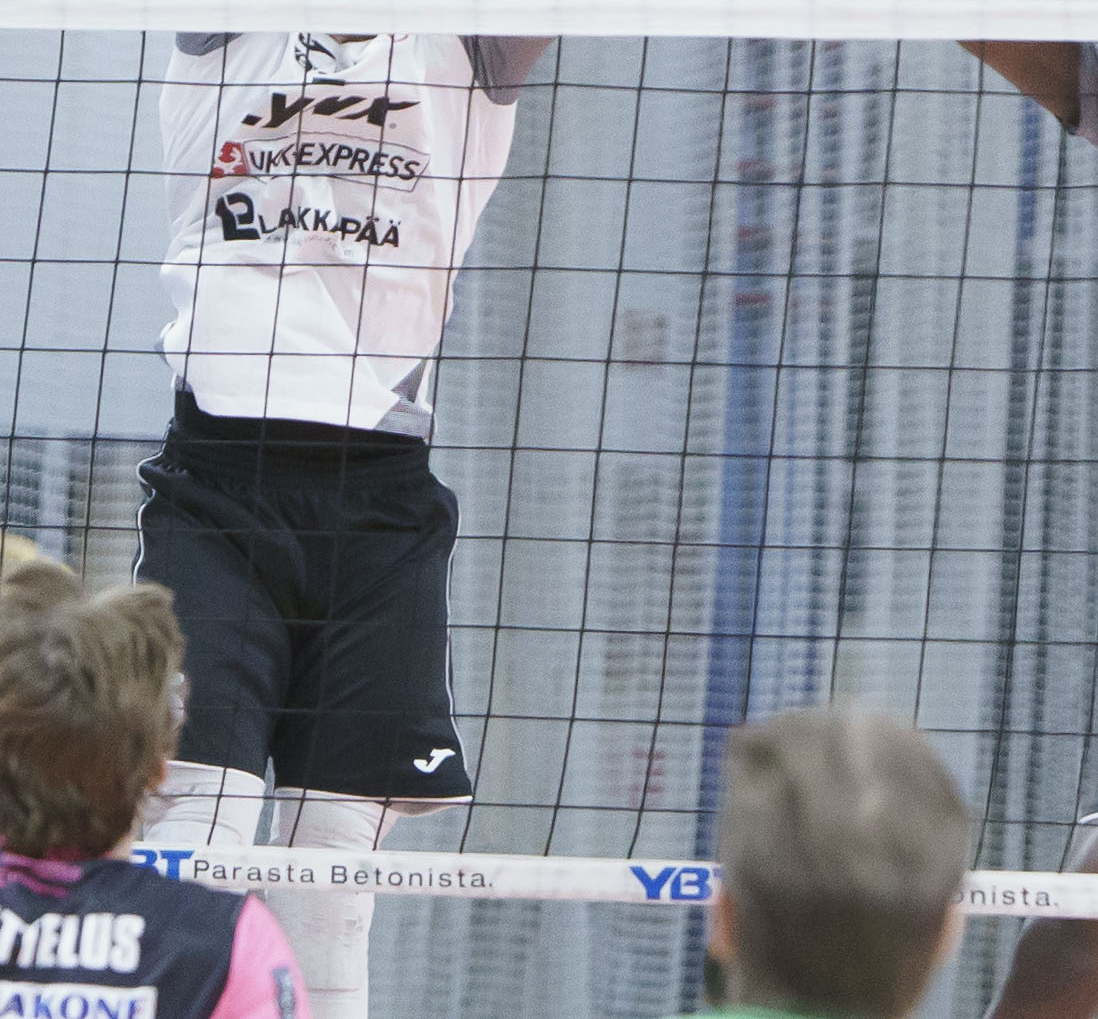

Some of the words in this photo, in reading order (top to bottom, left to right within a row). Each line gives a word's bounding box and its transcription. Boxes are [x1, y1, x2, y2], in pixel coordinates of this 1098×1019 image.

[192, 859, 316, 884] Parasta
[331, 864, 494, 889] Betonista.
[629, 865, 722, 901] YB
[960, 885, 1059, 907] nista.
